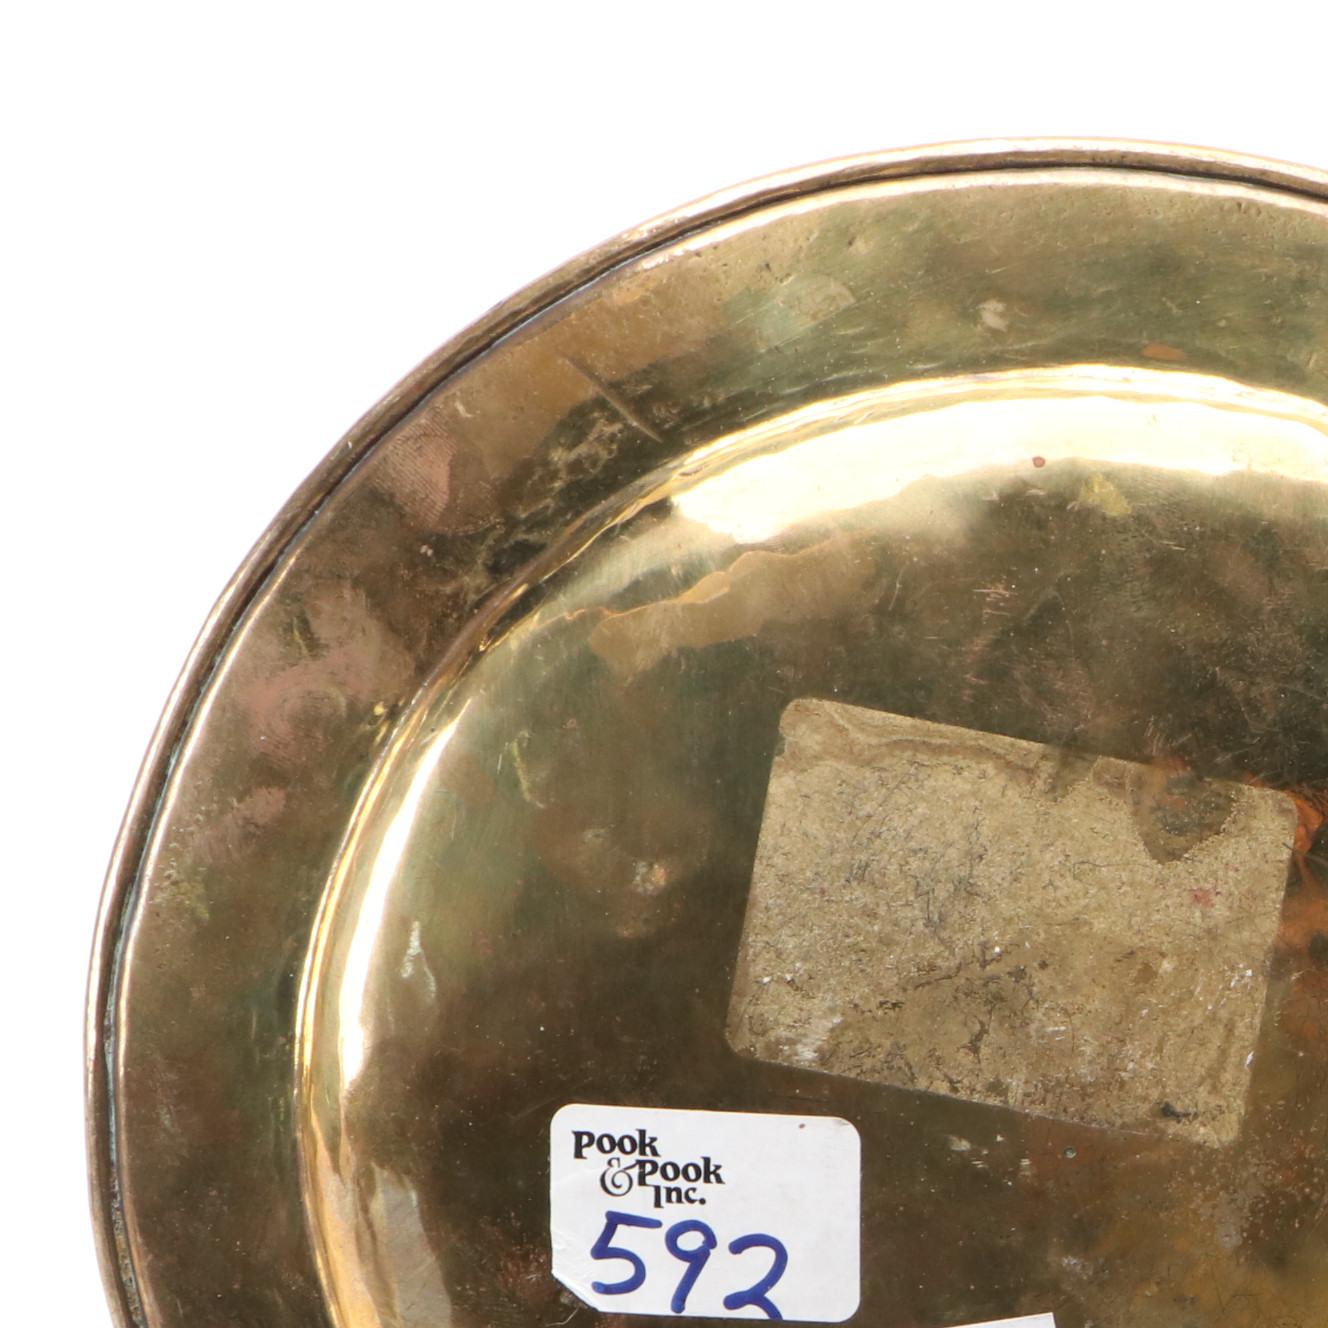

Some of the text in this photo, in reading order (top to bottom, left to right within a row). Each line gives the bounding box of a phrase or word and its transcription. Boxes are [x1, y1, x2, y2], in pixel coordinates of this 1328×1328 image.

[572, 1129, 661, 1159] Pook
[653, 1184, 707, 1208] Inc.
[590, 1210, 788, 1320] 592
